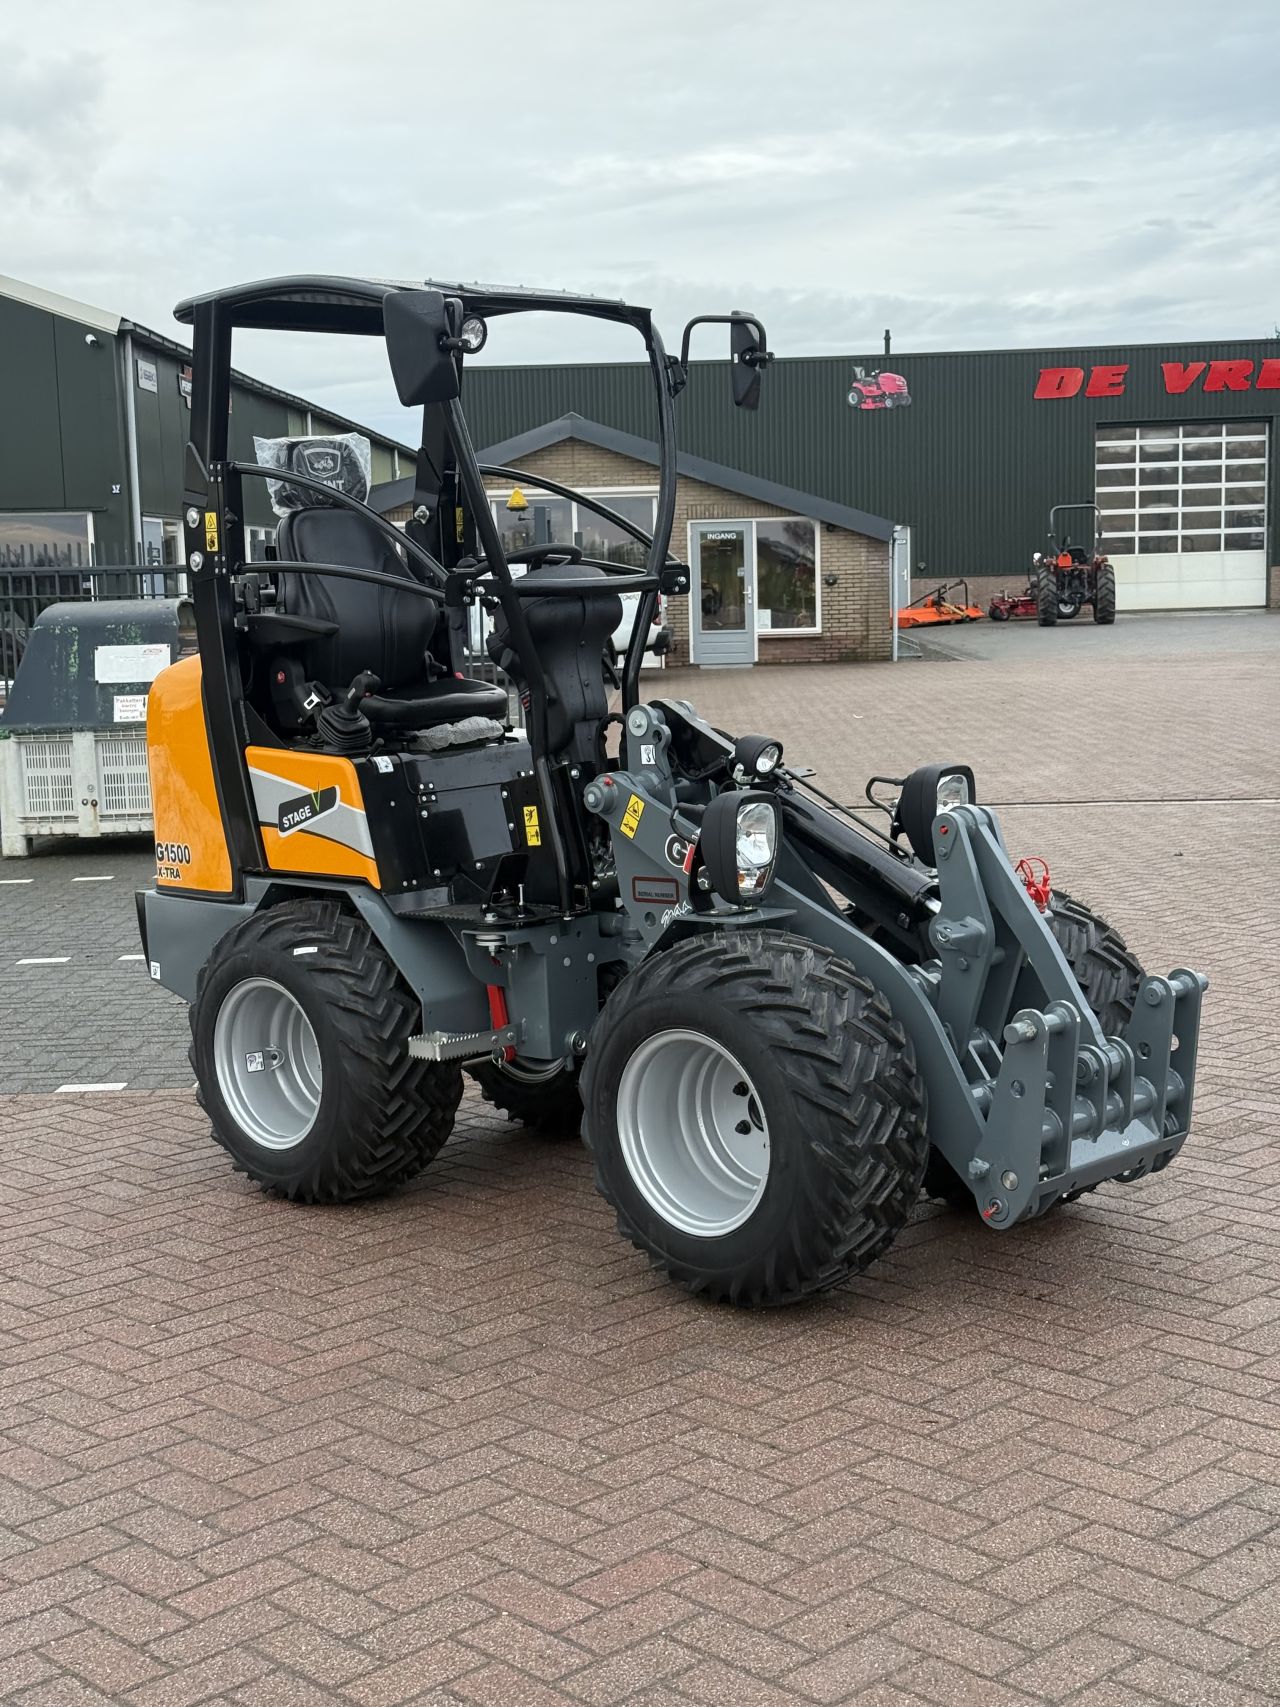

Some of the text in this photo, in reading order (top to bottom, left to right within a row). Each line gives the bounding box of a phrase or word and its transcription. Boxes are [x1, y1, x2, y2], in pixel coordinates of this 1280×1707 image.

[1034, 364, 1130, 399] DE
[707, 532, 737, 540] INGANG
[282, 805, 312, 828] STAGE
[156, 842, 191, 865] G1500
[158, 866, 181, 879] X-TRA
